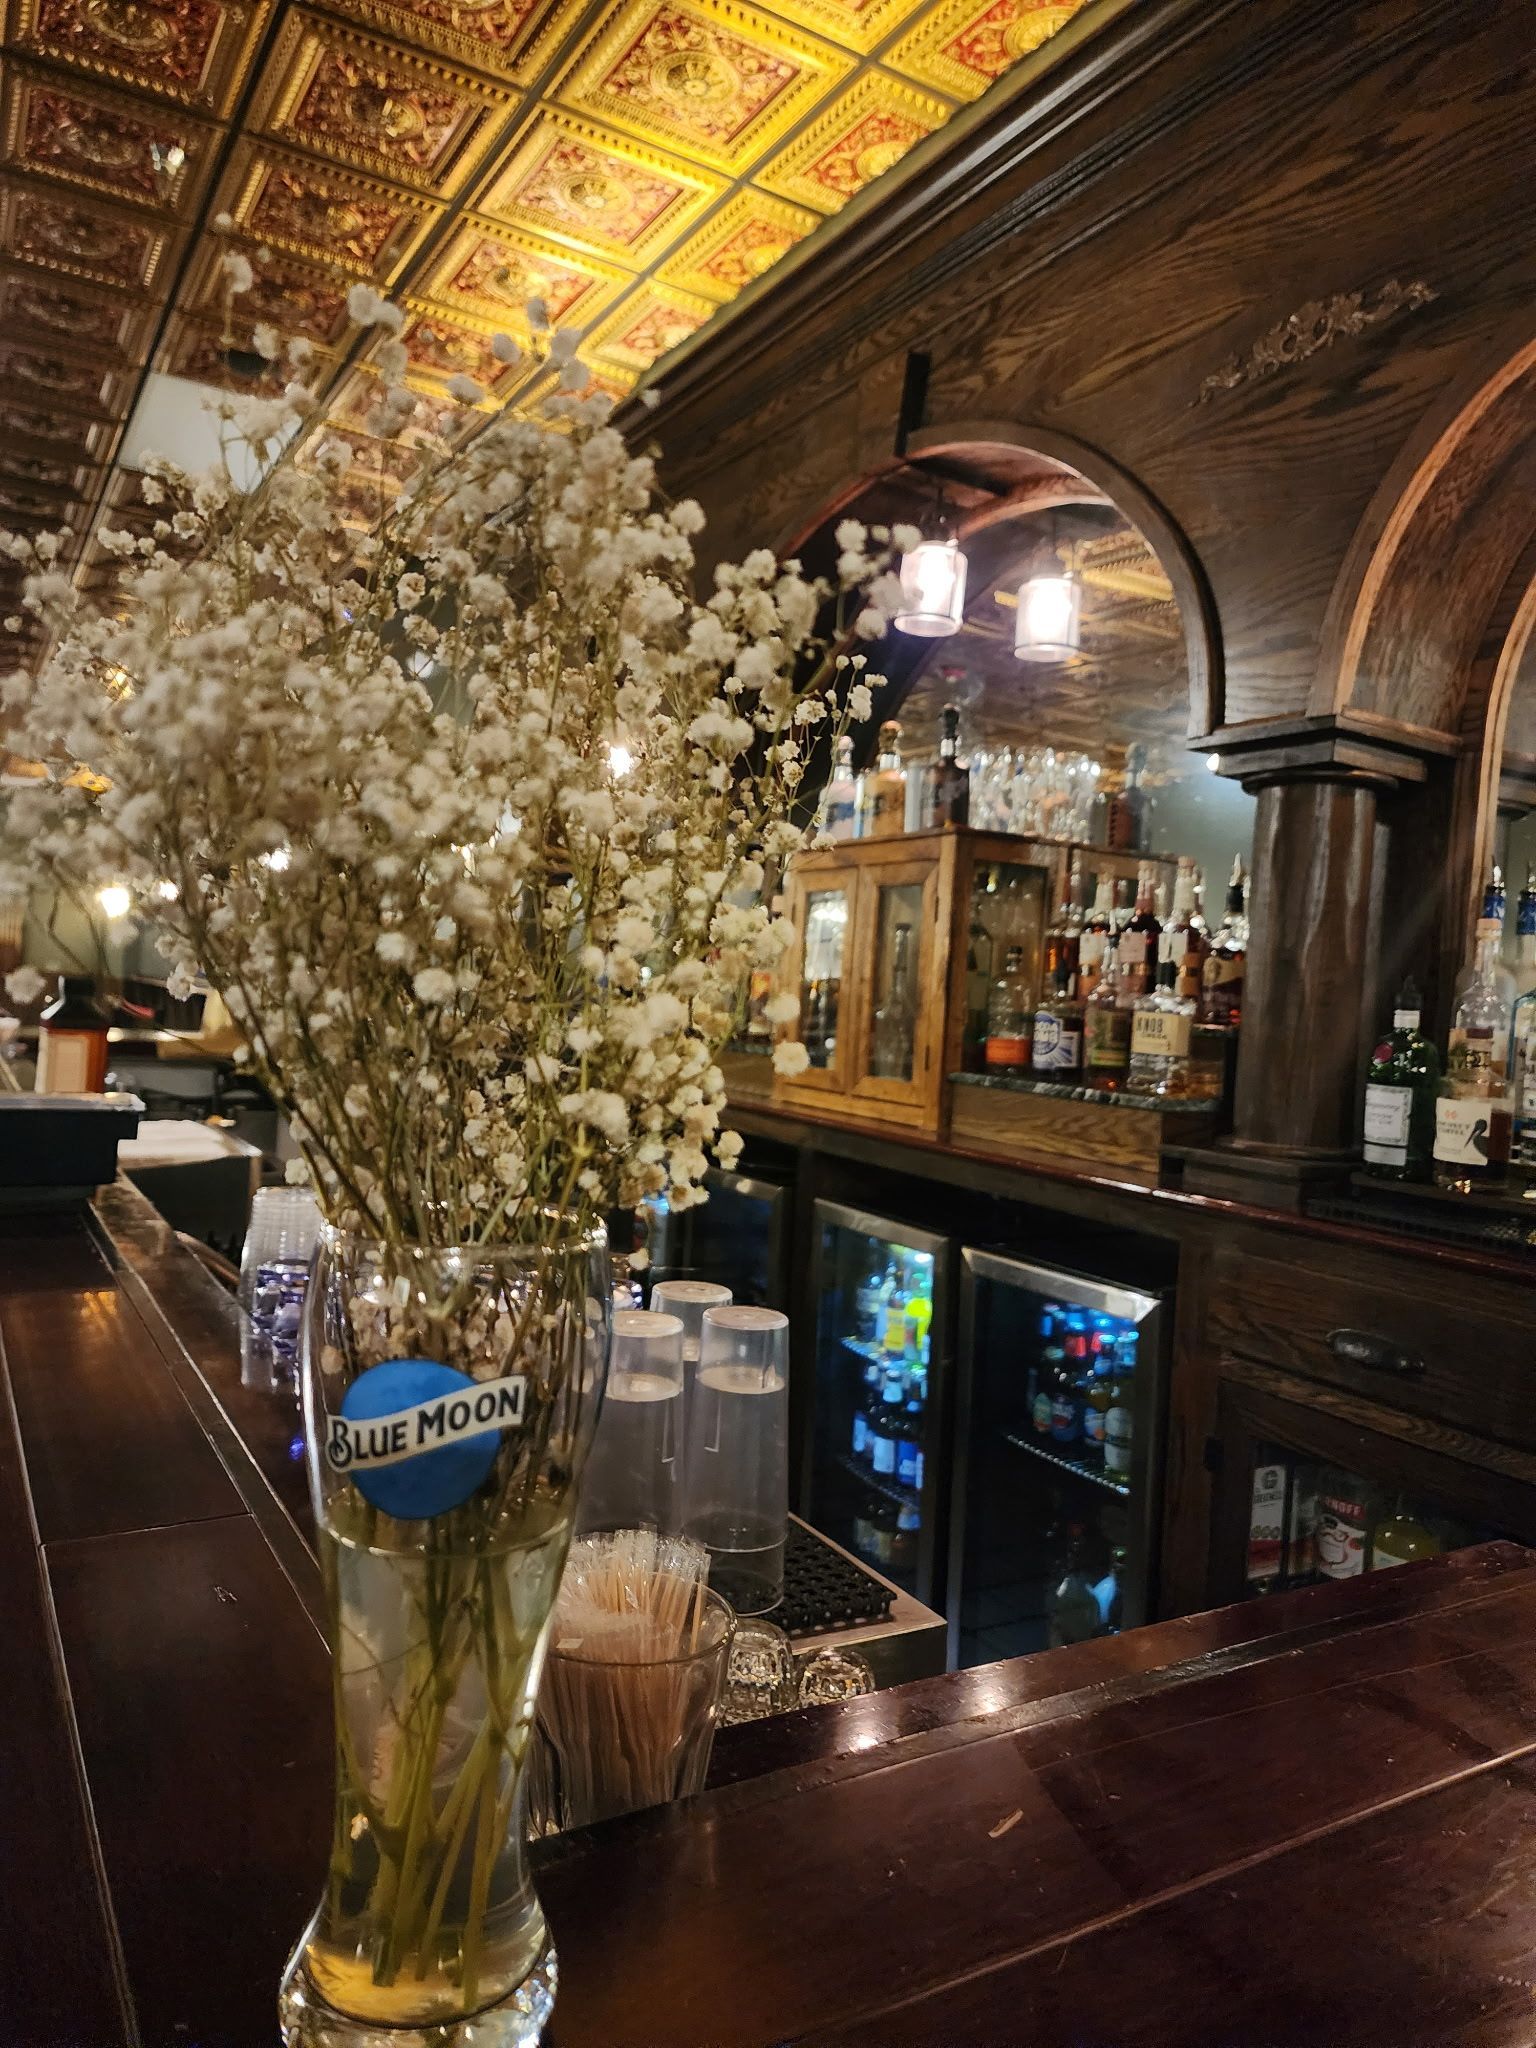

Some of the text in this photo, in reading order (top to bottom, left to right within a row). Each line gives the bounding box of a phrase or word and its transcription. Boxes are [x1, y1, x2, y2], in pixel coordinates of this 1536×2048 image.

[1135, 1017, 1163, 1033] KNOB
[328, 1384, 520, 1467] BLUE MOON
